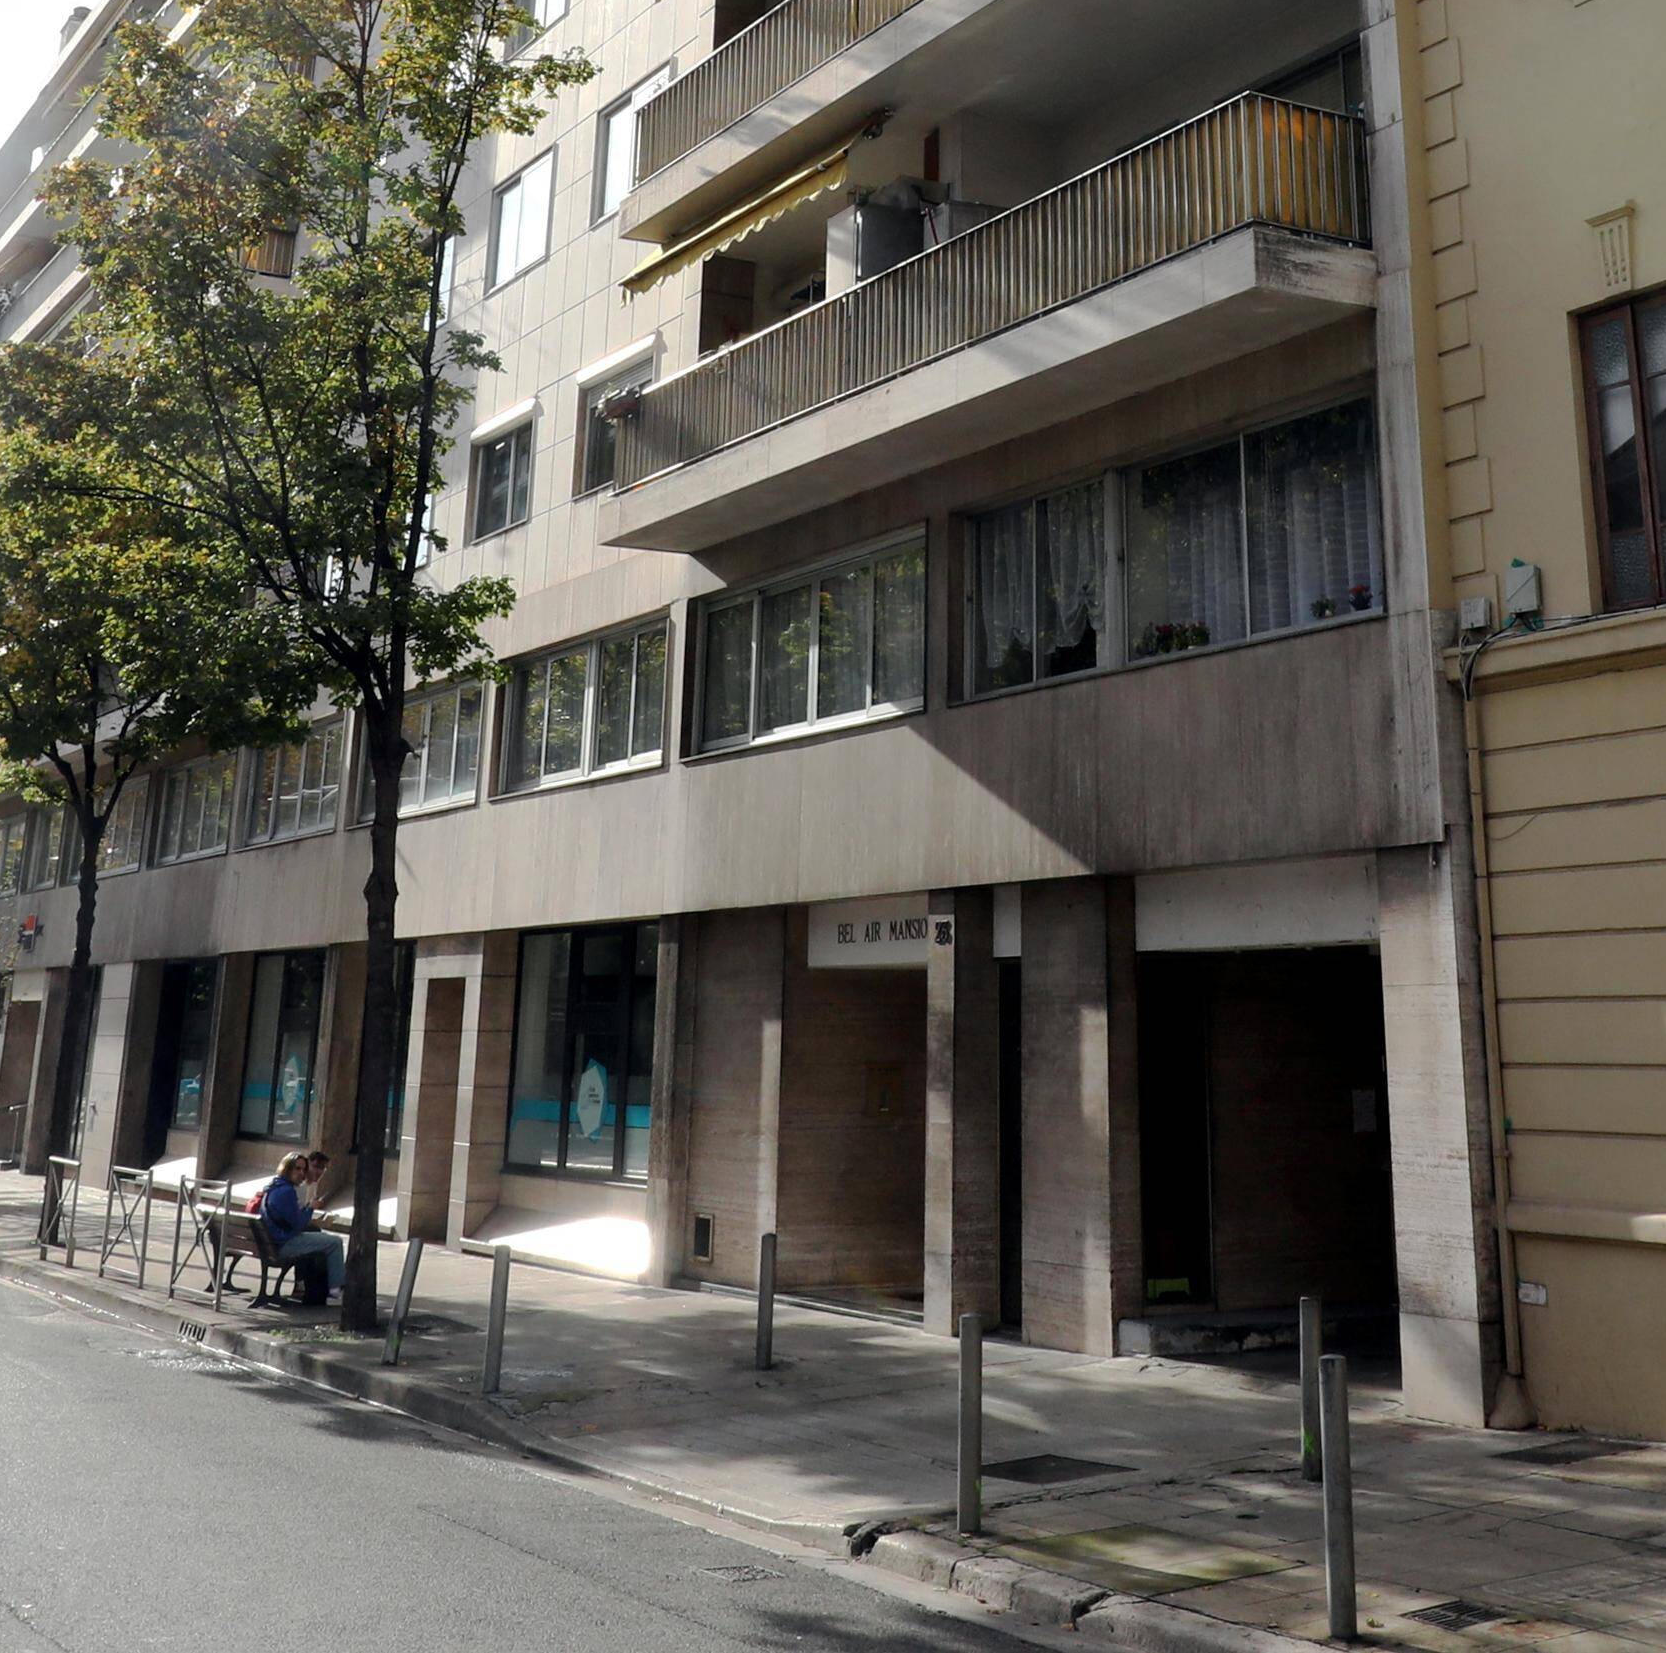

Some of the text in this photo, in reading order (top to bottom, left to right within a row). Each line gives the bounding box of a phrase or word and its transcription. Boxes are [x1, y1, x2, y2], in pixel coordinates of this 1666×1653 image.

[838, 923, 856, 944] BEL
[864, 921, 882, 943] AIR
[889, 918, 929, 941] MANSIO
